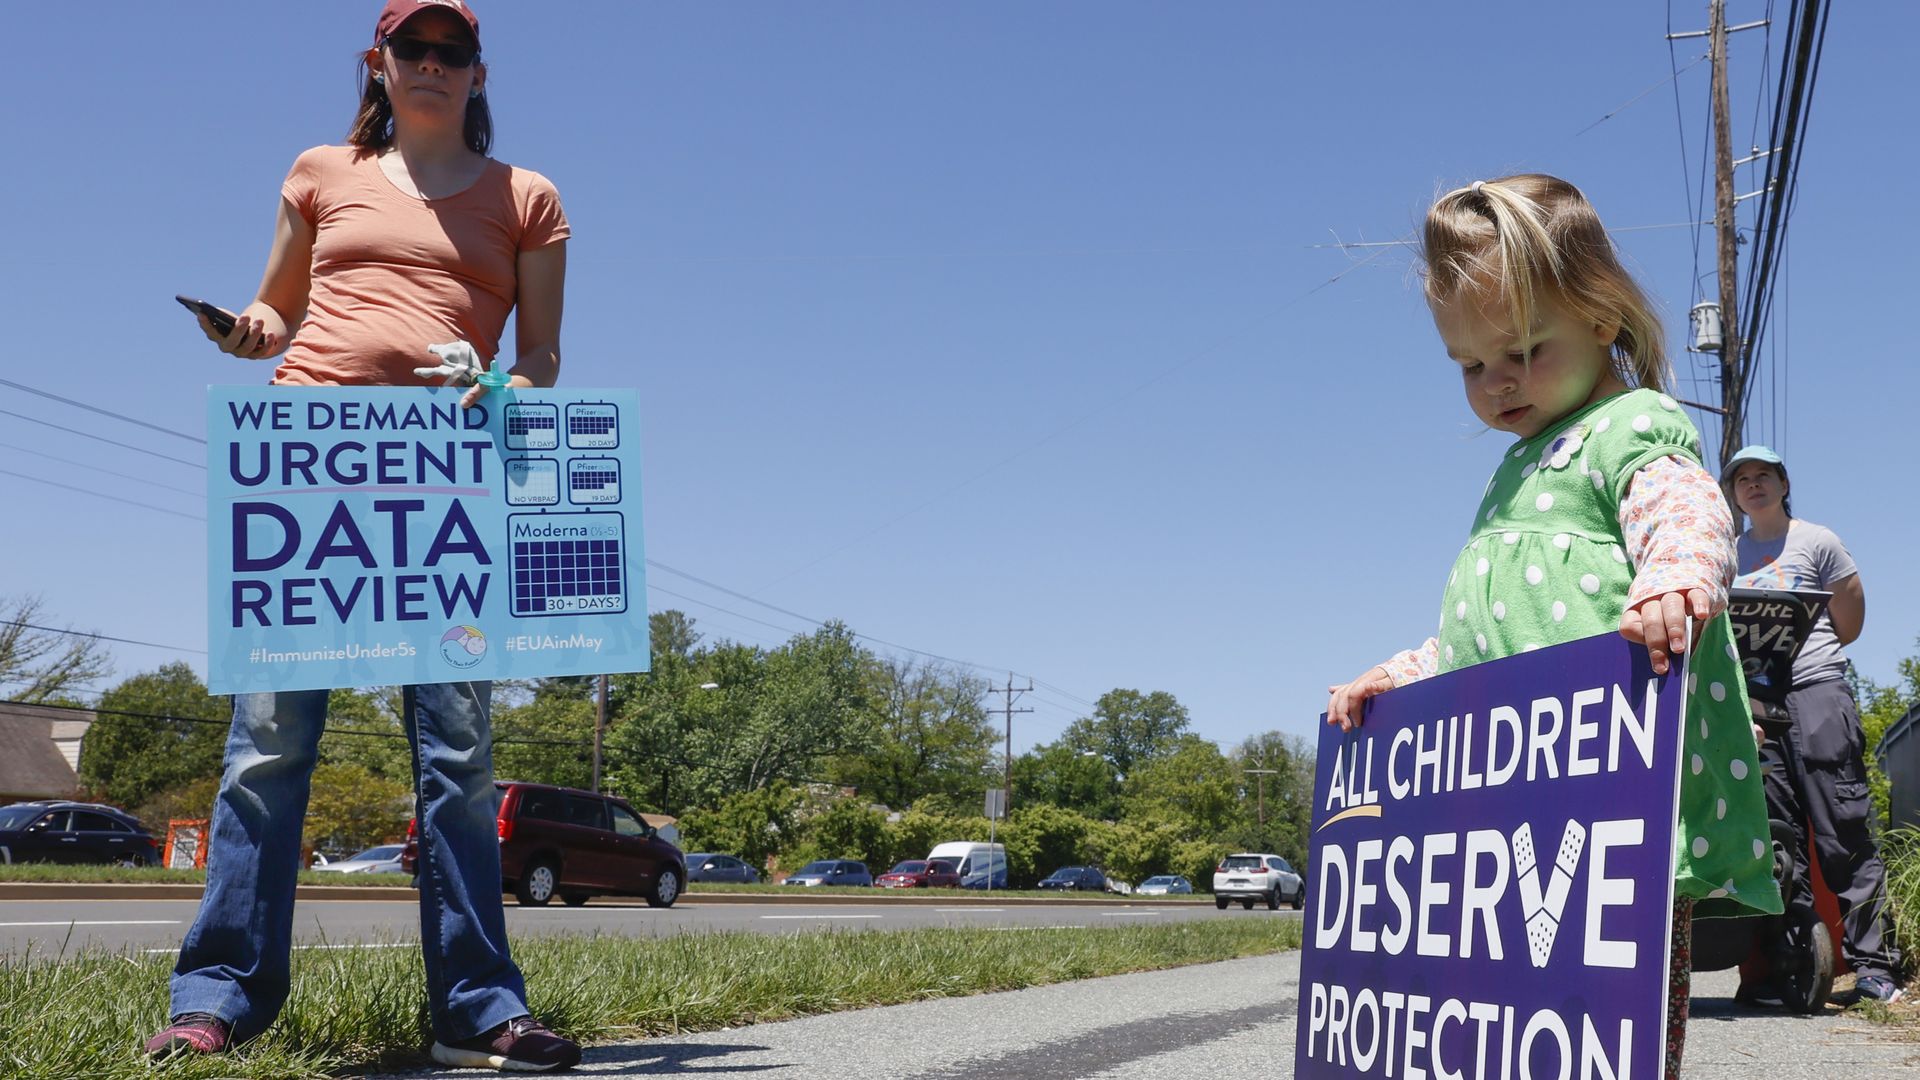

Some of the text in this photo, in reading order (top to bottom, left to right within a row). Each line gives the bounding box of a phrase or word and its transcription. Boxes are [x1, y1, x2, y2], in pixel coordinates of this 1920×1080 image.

[228, 401, 489, 430] WE DEMAND
[576, 408, 597, 416] Pfizer
[229, 440, 493, 487] URGENT
[513, 463, 535, 471] Pfizer
[577, 463, 598, 471] Pfizer
[232, 498, 493, 572] DATA
[515, 522, 588, 538] Moderna
[232, 573, 491, 627] REVIEW
[548, 596, 621, 610] 30+ DAYS?
[249, 642, 417, 664] #ImmunizeUnder5s
[504, 633, 603, 653] #EUAinMay
[1325, 678, 1659, 811] ALL CHILDREN
[1315, 818, 1645, 969] DESERVE
[1307, 982, 1634, 1080] PROTECTION
